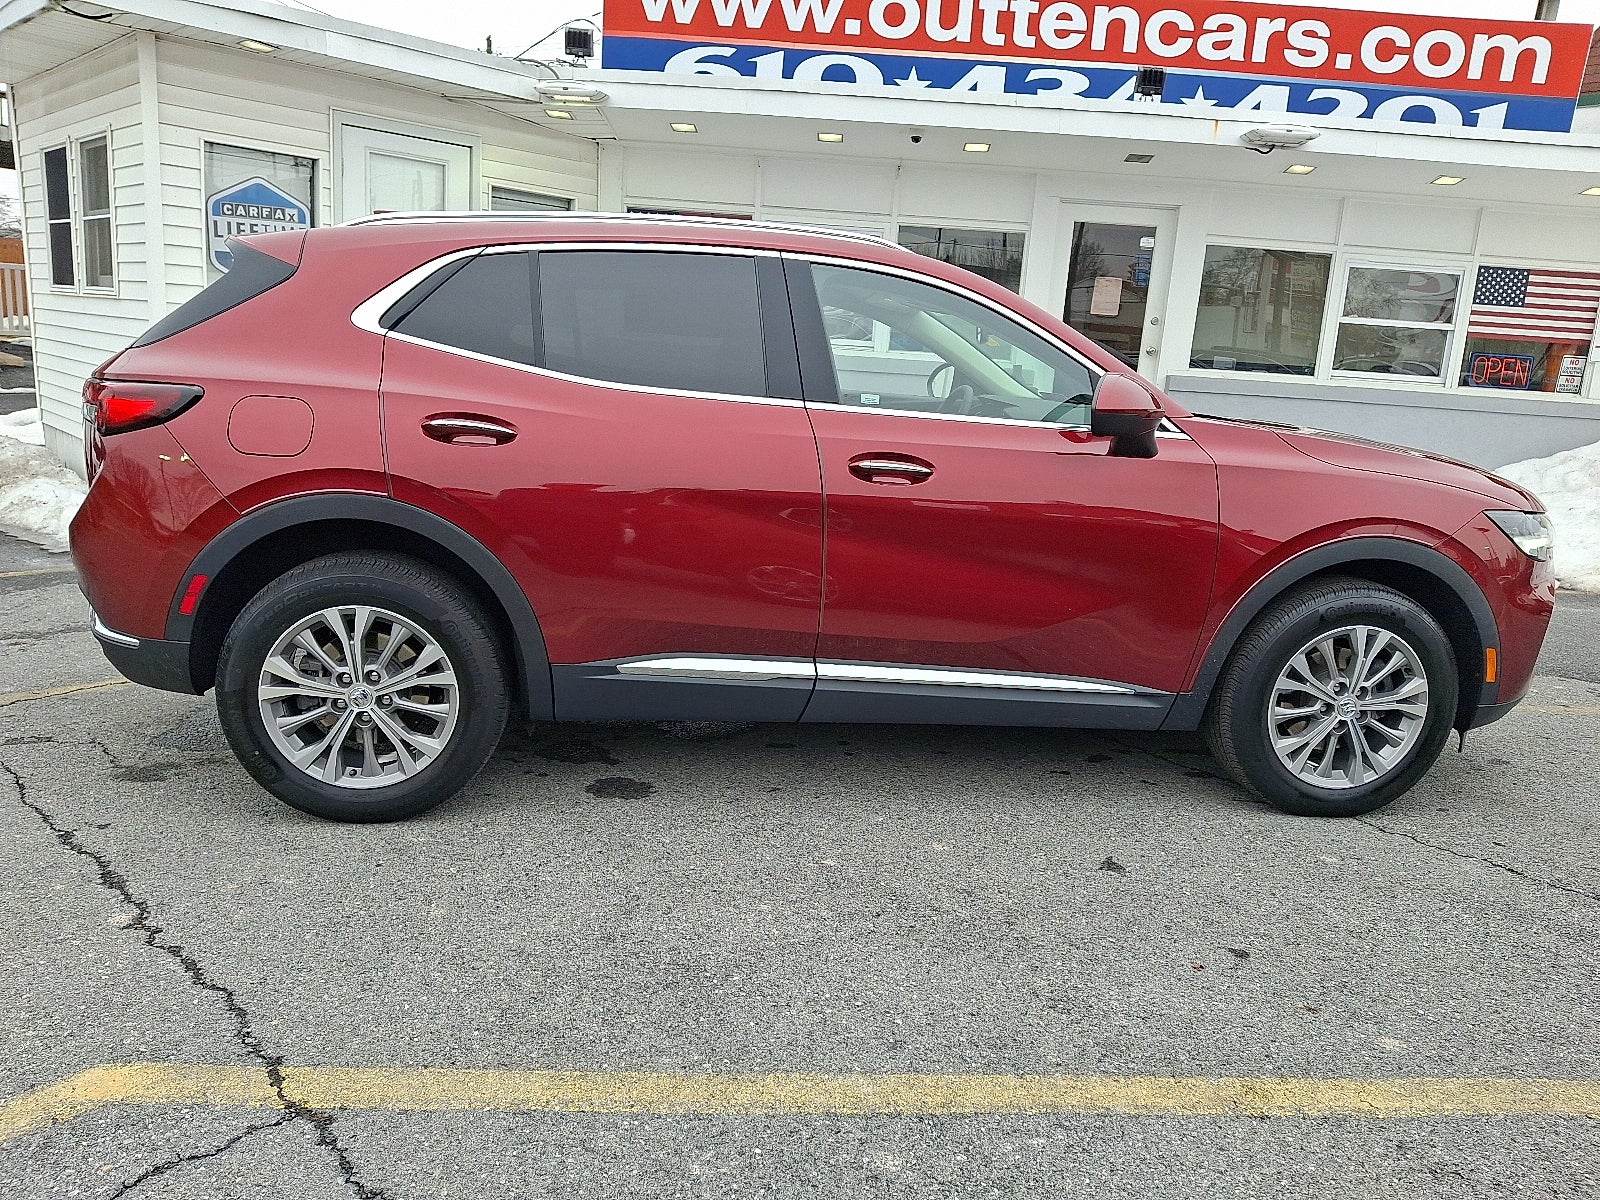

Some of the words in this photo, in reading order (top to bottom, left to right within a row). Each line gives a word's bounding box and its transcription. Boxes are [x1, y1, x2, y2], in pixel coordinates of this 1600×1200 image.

[641, 0, 1552, 85] www.outtencars.com
[222, 203, 296, 222] CARFAX
[213, 219, 306, 238] LIFE
[1472, 356, 1530, 385] OPEN
